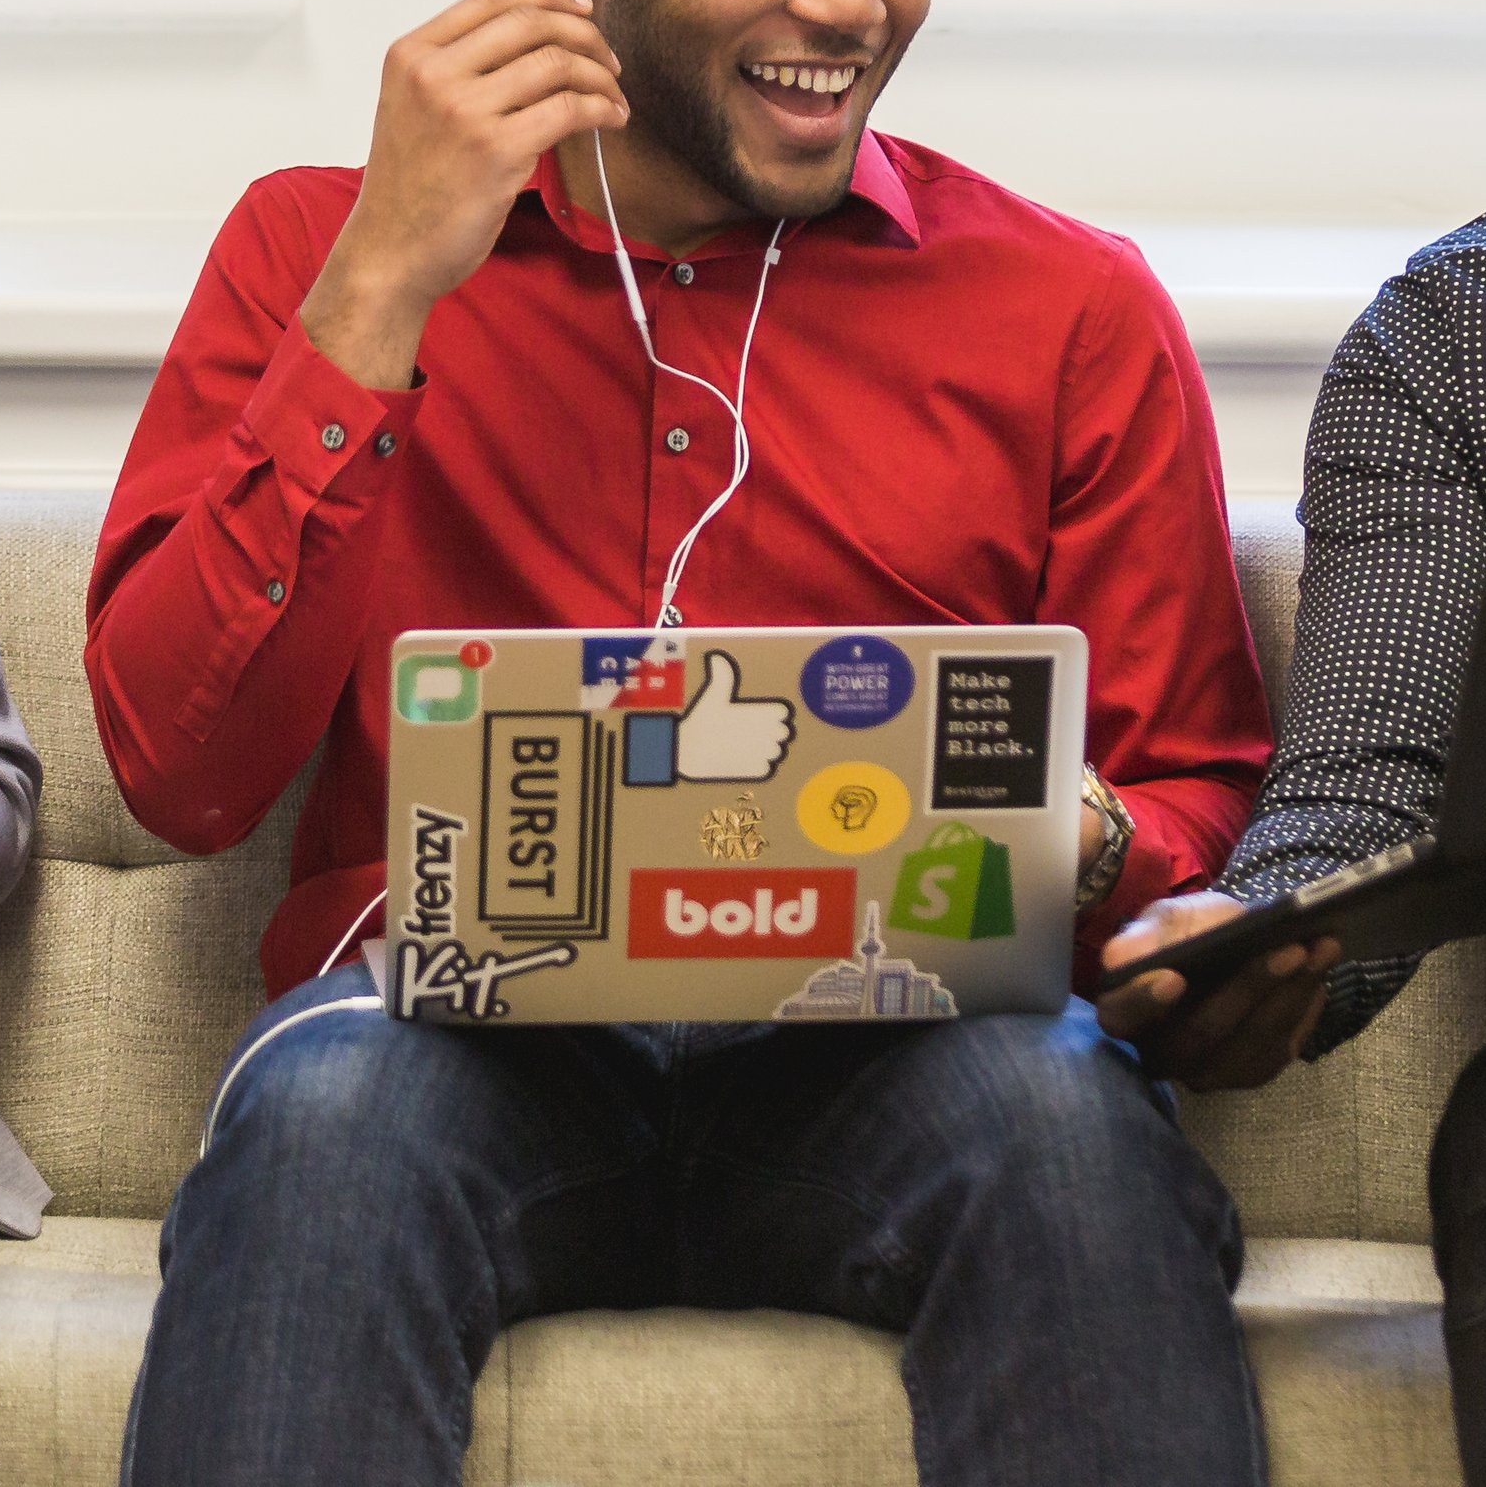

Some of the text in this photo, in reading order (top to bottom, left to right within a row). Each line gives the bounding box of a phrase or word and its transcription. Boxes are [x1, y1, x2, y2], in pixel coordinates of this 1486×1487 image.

[825, 675, 889, 690] POWER
[948, 672, 1011, 690] Make
[948, 694, 1011, 712] tech
[946, 720, 1010, 734] more
[945, 739, 1034, 757] Black.
[507, 736, 560, 898] BURST
[404, 808, 463, 936] frenzy
[664, 888, 819, 938] bold
